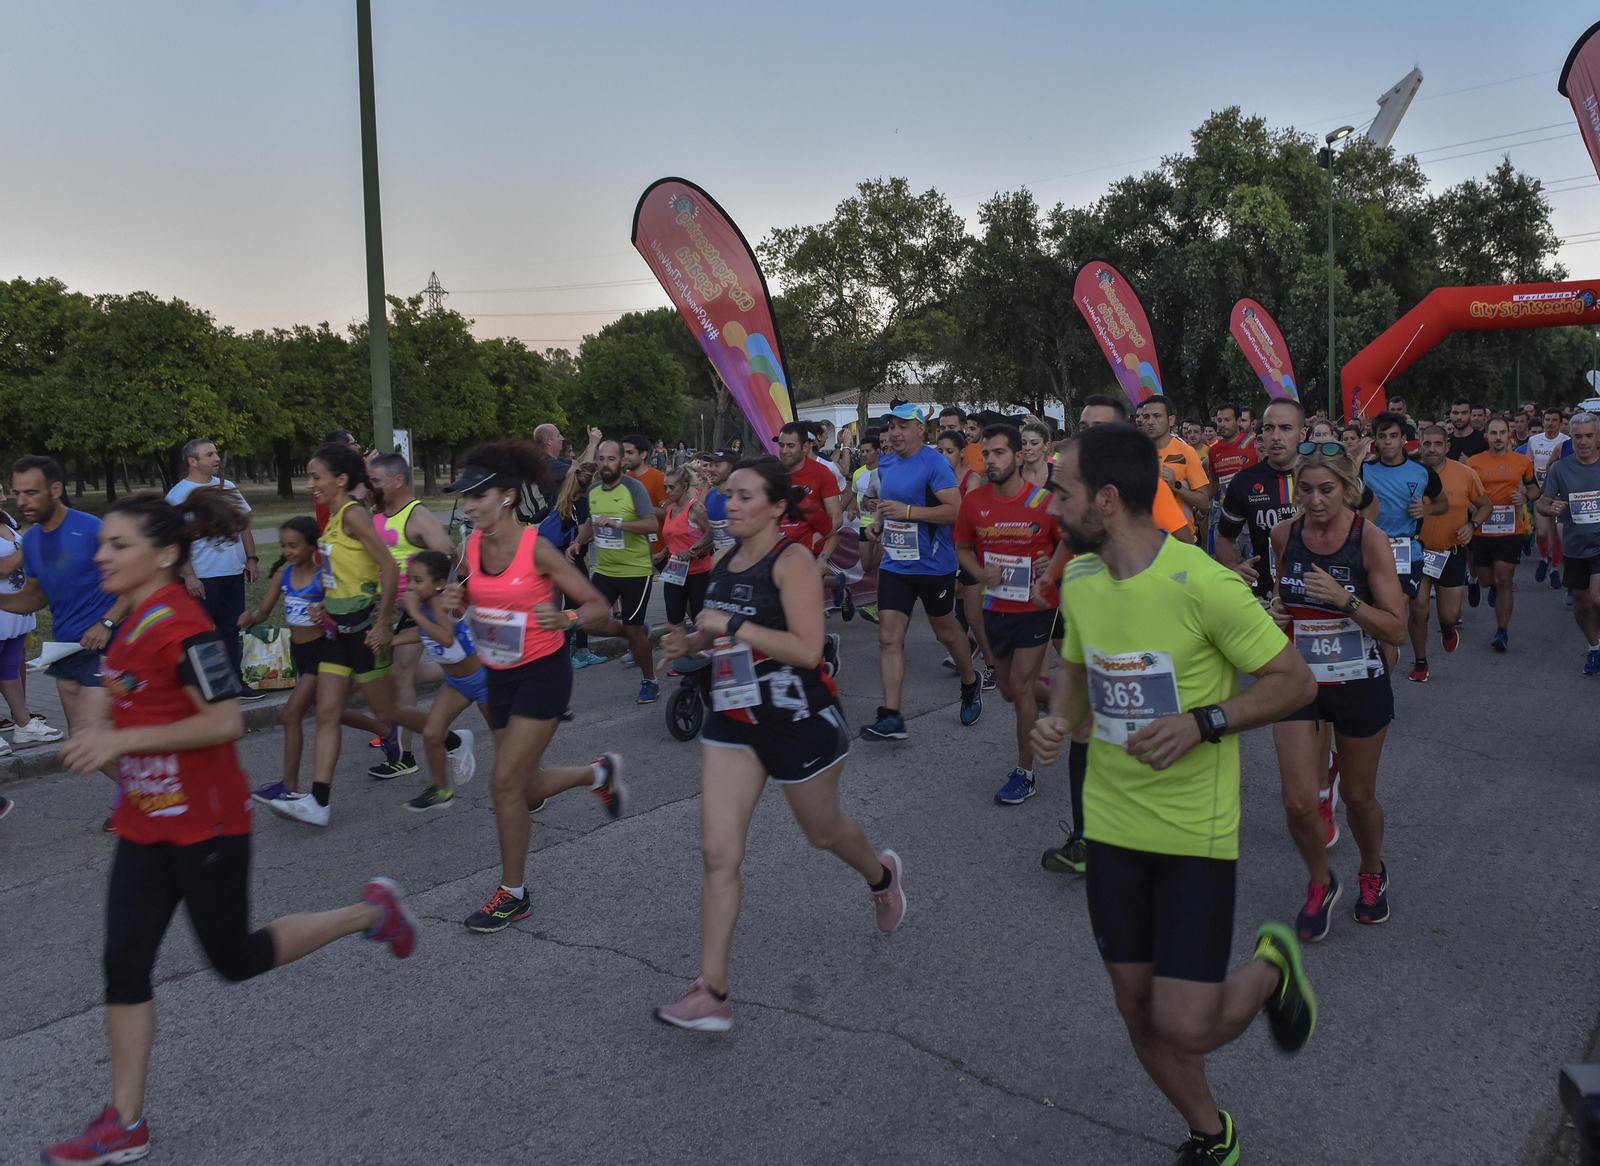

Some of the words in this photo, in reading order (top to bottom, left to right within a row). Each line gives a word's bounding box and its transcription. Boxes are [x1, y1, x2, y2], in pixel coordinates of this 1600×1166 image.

[1580, 501, 1598, 510] 226
[1256, 509, 1277, 530] 40
[1491, 514, 1505, 522] 492
[890, 533, 905, 545] 138
[1311, 637, 1342, 656] 464
[1102, 681, 1144, 708] 363
